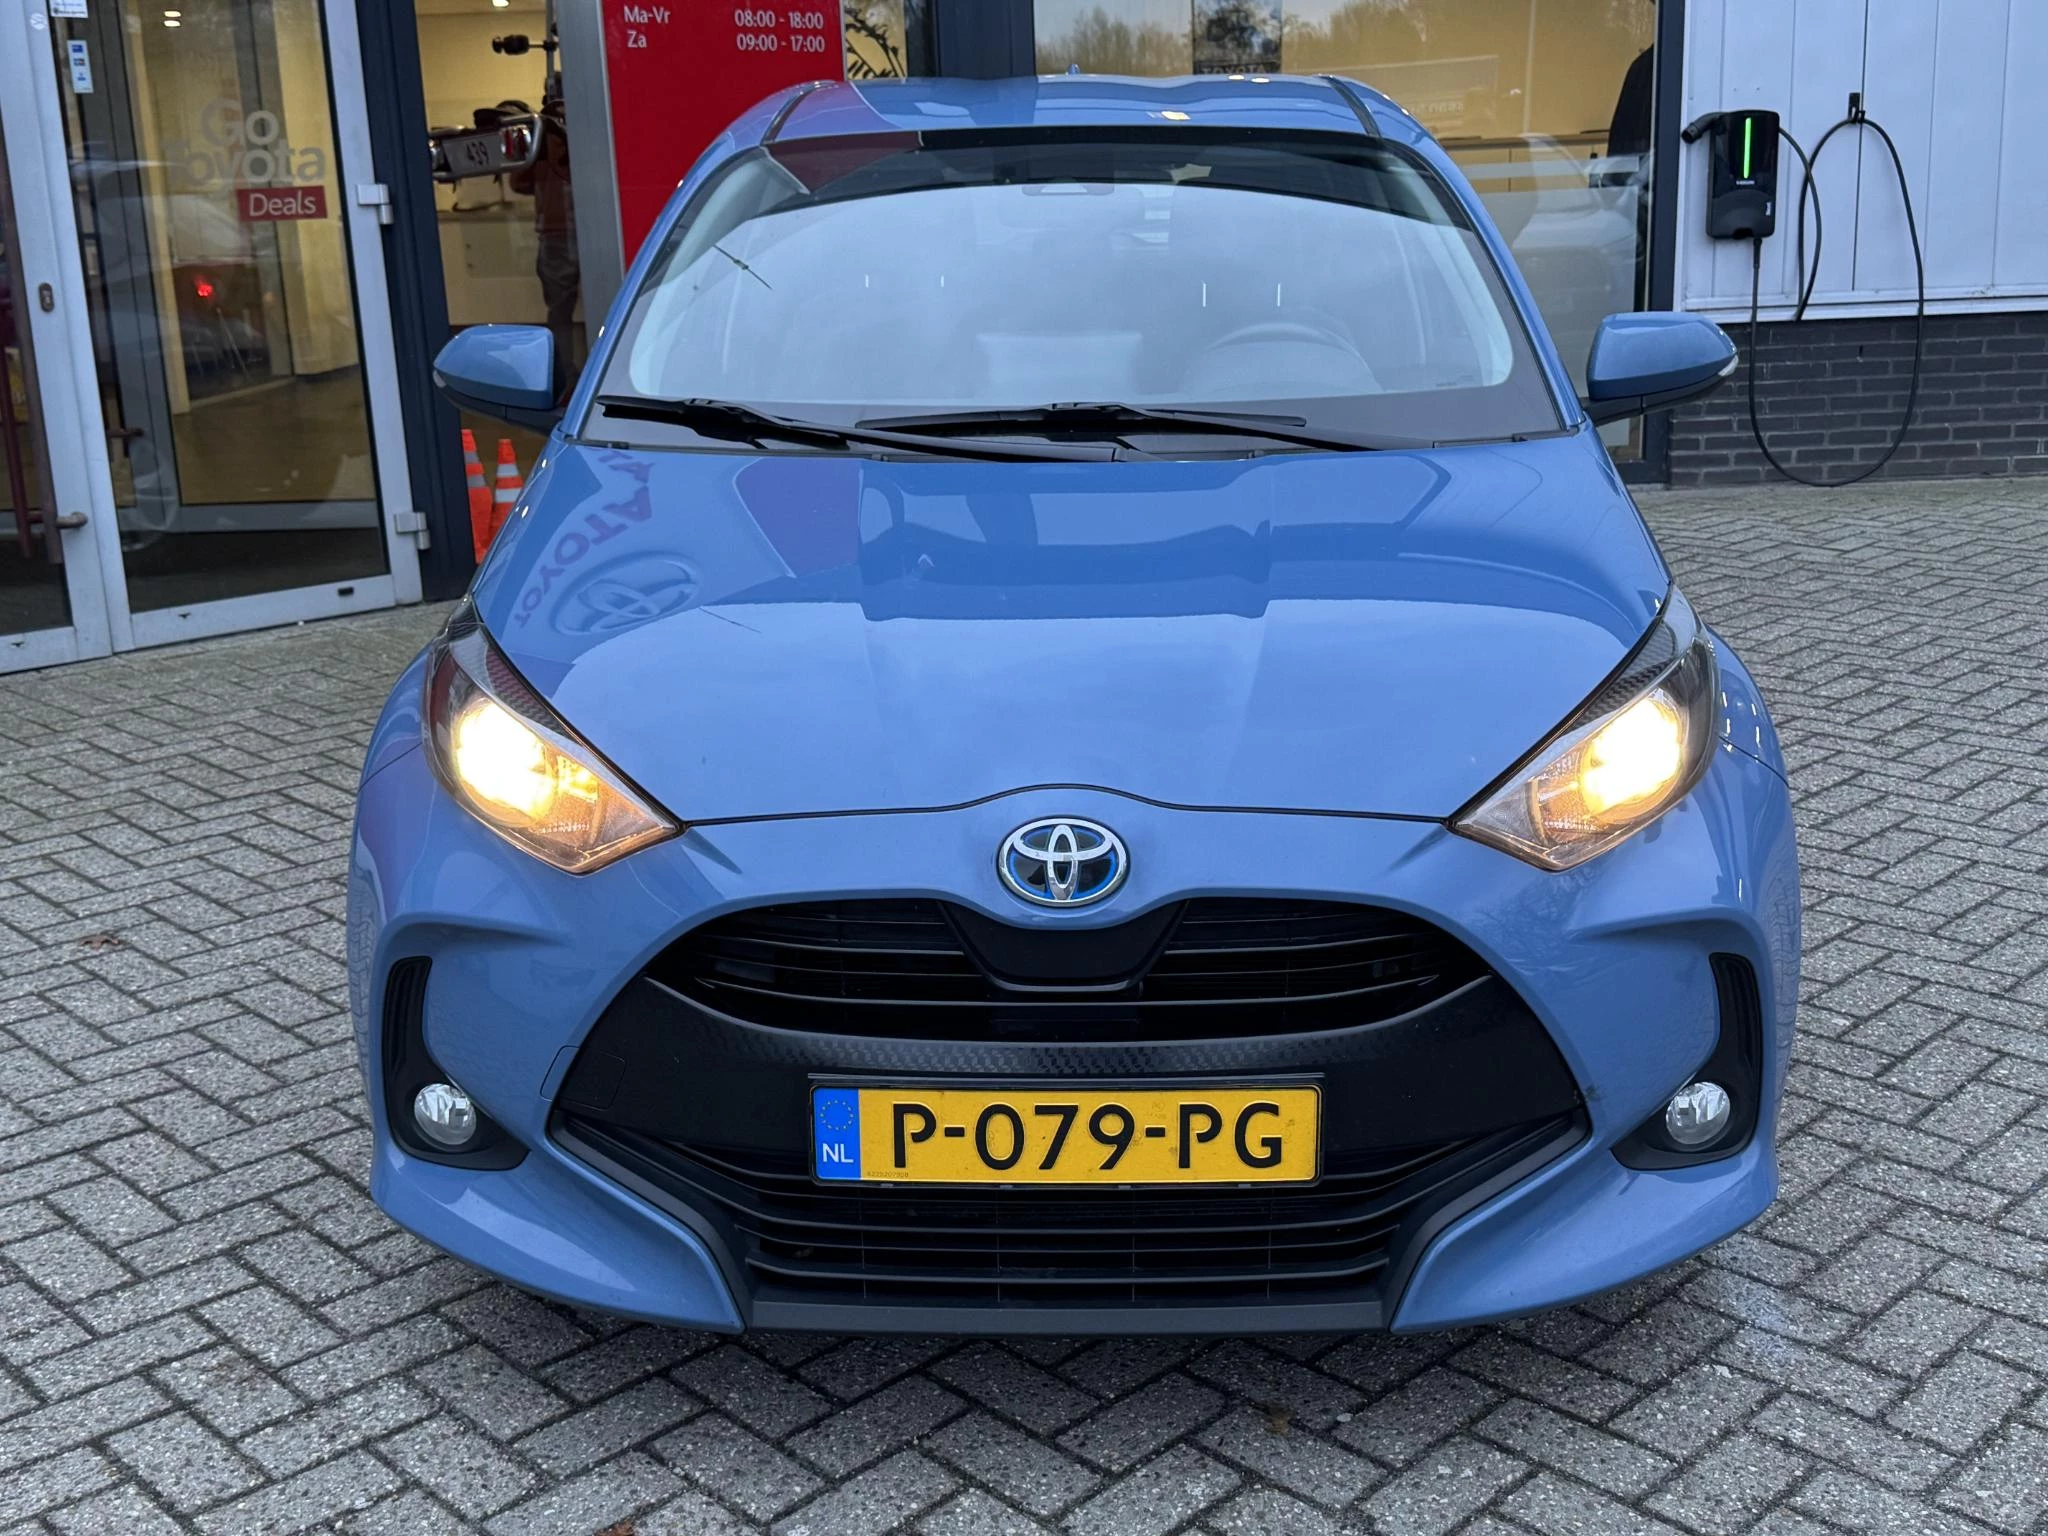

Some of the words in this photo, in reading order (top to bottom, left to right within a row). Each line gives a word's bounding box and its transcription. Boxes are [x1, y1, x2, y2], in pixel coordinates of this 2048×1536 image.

[624, 5, 671, 25] Ma-Vr
[734, 9, 776, 28] 08:00
[788, 11, 824, 29] 18:00
[627, 30, 648, 48] Za
[736, 33, 777, 51] 09:00
[790, 35, 825, 52] 17:00
[202, 98, 279, 147] Go
[161, 138, 326, 198] Toyota
[250, 191, 316, 216] Deals
[892, 1102, 1283, 1171] P-079-PG
[822, 1143, 854, 1163] NL
